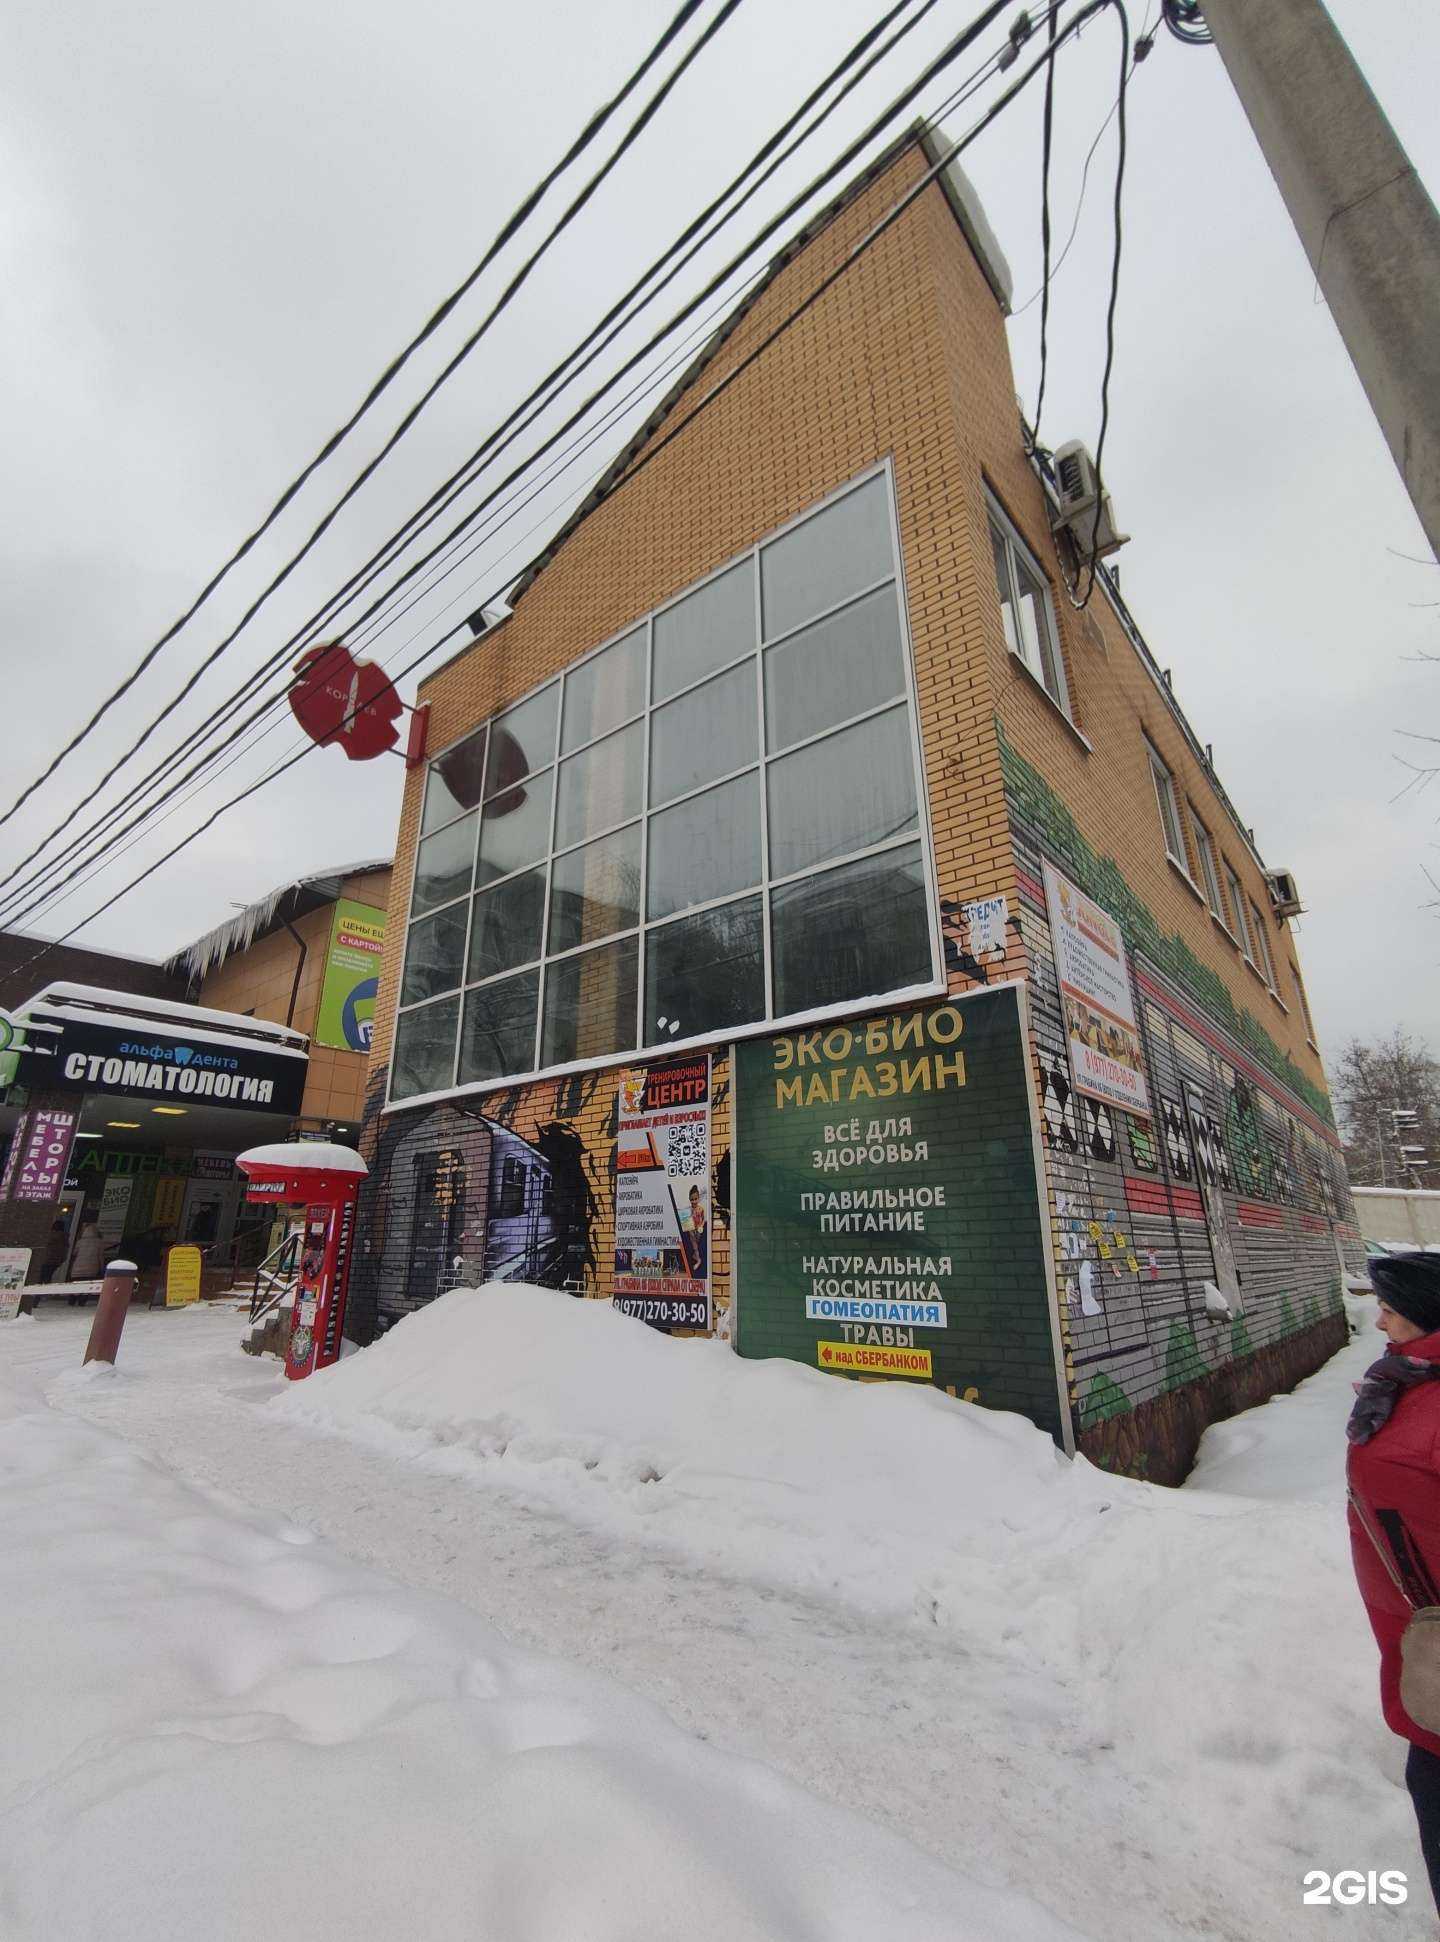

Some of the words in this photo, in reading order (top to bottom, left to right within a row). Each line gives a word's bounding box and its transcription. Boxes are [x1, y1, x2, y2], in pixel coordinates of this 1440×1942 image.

[340, 935, 347, 943] С
[342, 921, 370, 934] ЦЕНЫ
[119, 1042, 173, 1060] альфа
[191, 1054, 238, 1069] дента
[64, 1052, 274, 1103] СТОМАТОЛОГИЯ
[647, 1063, 706, 1085] ТРЕНИРОВОЧНЫЙ
[776, 1051, 966, 1109] МАГАЗИН
[647, 1079, 706, 1108] ЦЕНТР
[824, 1118, 860, 1143] ВСЁ
[865, 1117, 912, 1144] ДЛЯ
[23, 1111, 52, 1183] МЕБЕЛЬ
[38, 1113, 74, 1185] ШТОРЫ
[812, 1141, 929, 1172] ЗДОРОВЬЯ
[800, 1186, 946, 1211] ПРАВИЛЬНОЕ
[820, 1211, 925, 1233] ПИТАНИЕ
[802, 1256, 952, 1276] НАТУРАЛЬНАЯ
[812, 1279, 943, 1301] КОСМЕТИКА
[812, 1300, 940, 1323] ГОМЕОПАТИЯ
[840, 1324, 914, 1348] ТРАВЫ
[835, 1352, 853, 1365] над
[855, 1351, 928, 1371] СБЕРБАНКОМ
